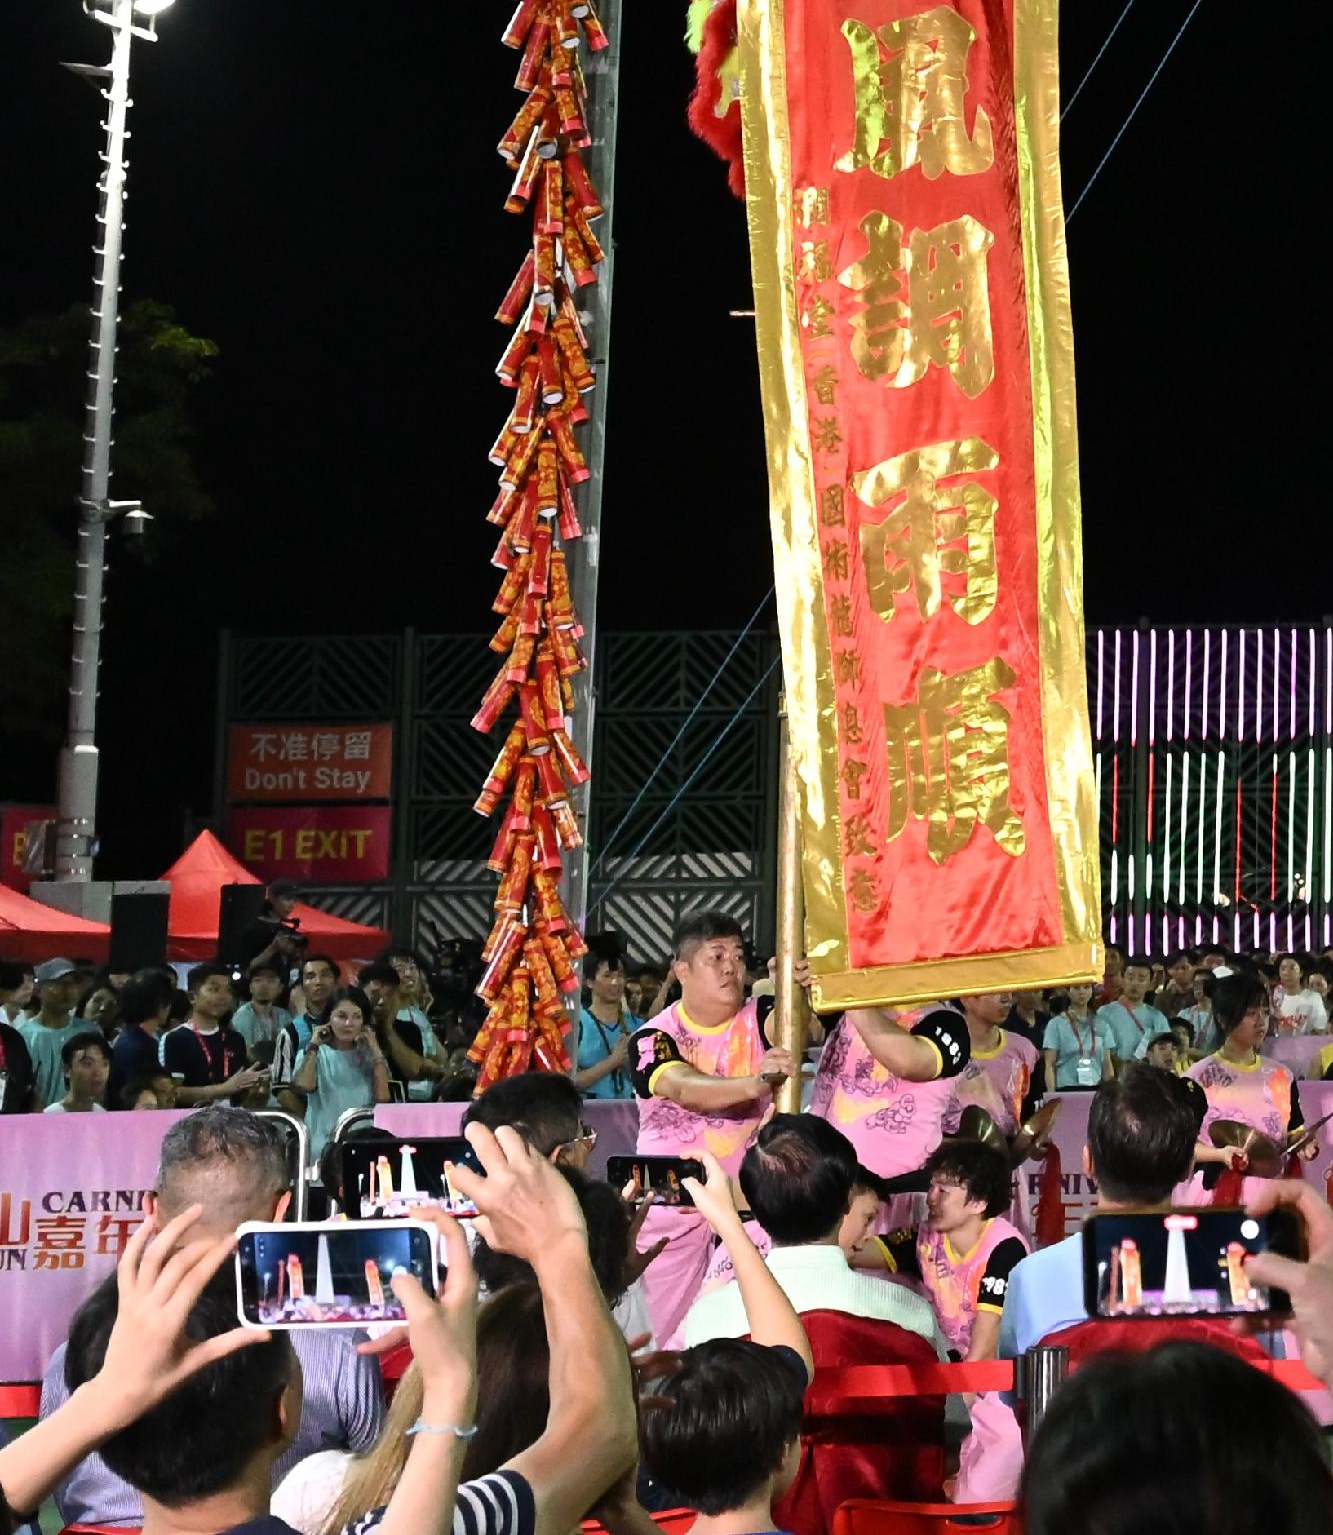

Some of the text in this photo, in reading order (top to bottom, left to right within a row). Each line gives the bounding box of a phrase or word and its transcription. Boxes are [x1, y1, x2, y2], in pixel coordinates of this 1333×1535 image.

[832, 3, 1027, 868] 風調雨順
[249, 730, 372, 763] 不准停留
[244, 766, 372, 794] Don't Stay
[244, 829, 374, 862] E1 EXIT
